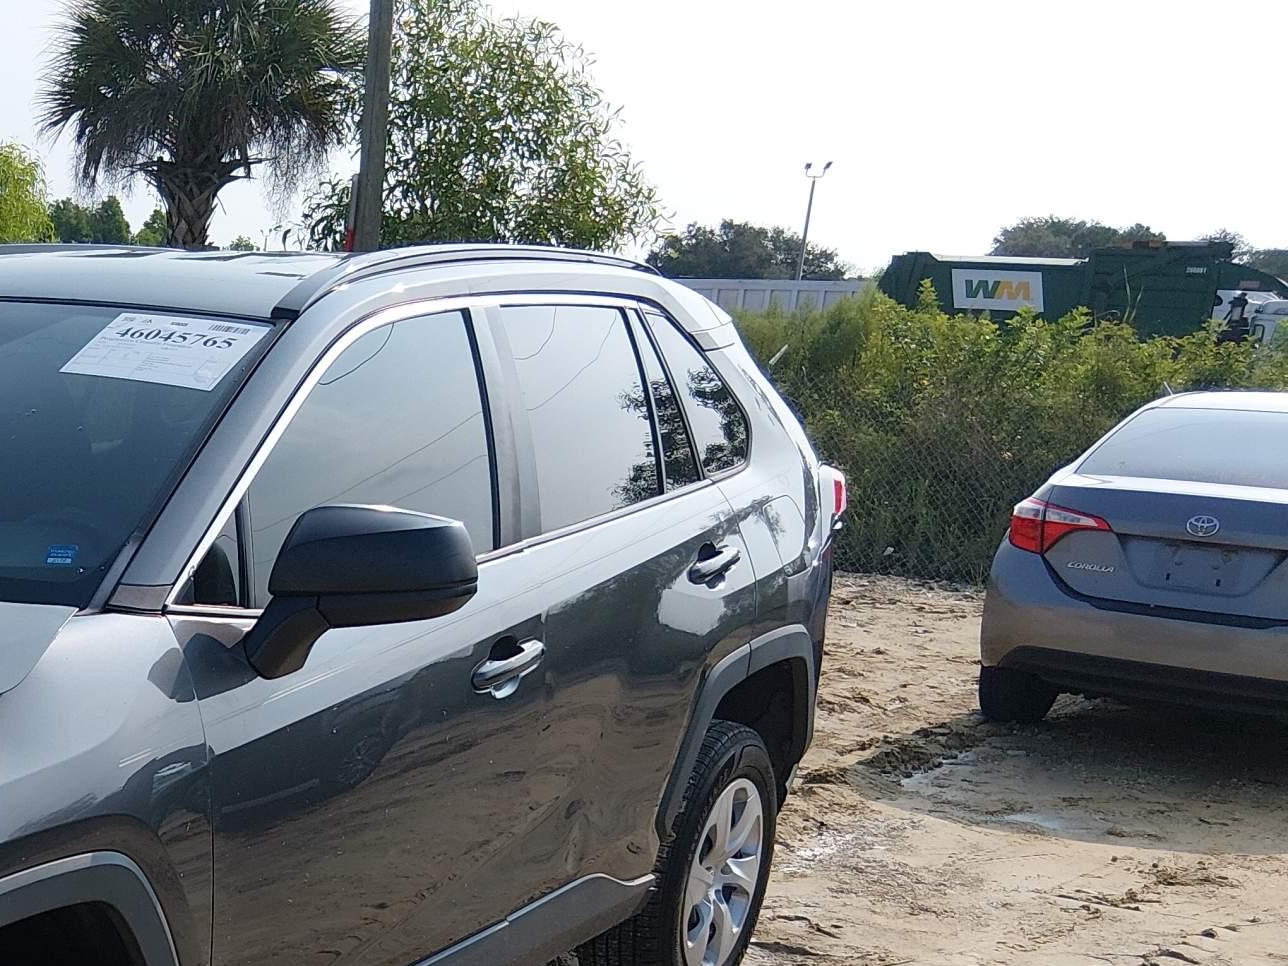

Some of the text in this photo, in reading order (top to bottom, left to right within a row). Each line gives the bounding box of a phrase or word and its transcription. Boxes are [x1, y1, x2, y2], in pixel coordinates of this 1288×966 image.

[965, 279, 1031, 300] WM
[115, 326, 238, 349] 46045765
[1067, 560, 1115, 573] COROLLA
